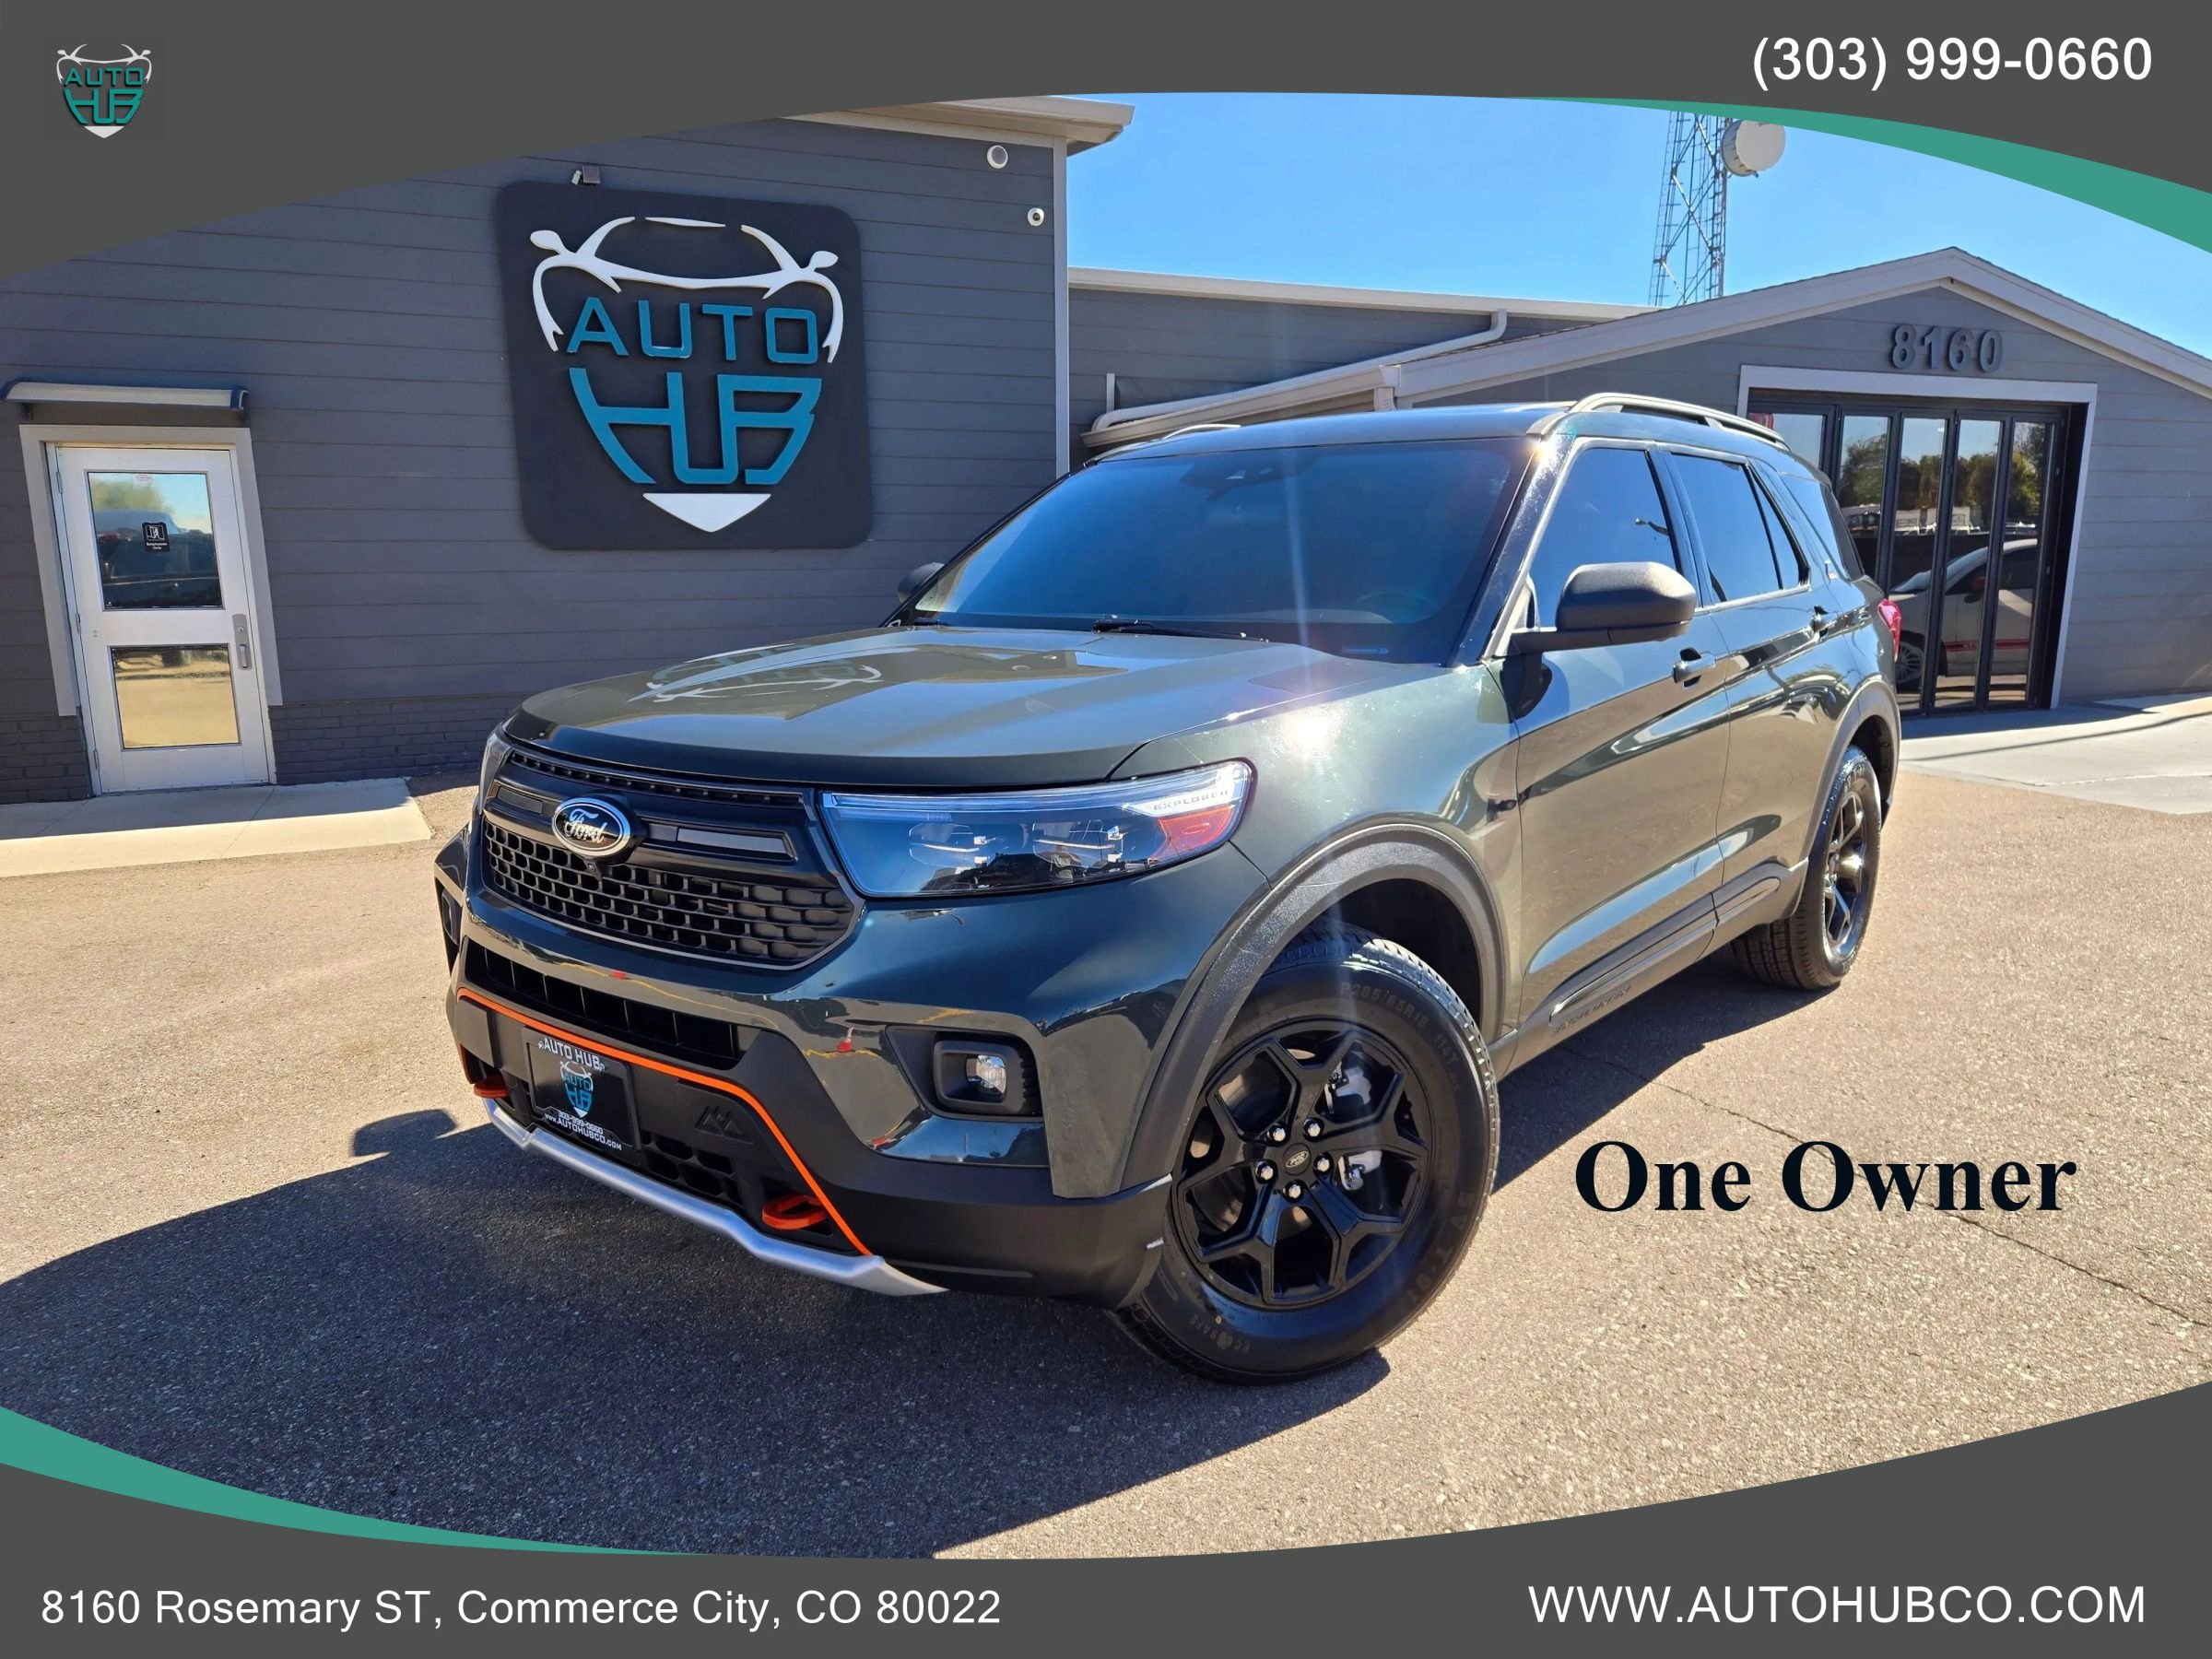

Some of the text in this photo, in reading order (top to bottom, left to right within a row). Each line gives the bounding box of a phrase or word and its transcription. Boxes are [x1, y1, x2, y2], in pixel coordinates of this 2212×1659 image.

[566, 297, 819, 364] AUTO
[1889, 324, 2003, 373] 8160
[569, 367, 823, 486] HUB
[564, 808, 609, 844] Ford
[543, 1037, 601, 1070] AUTO HUB
[563, 1073, 592, 1090] AUTO
